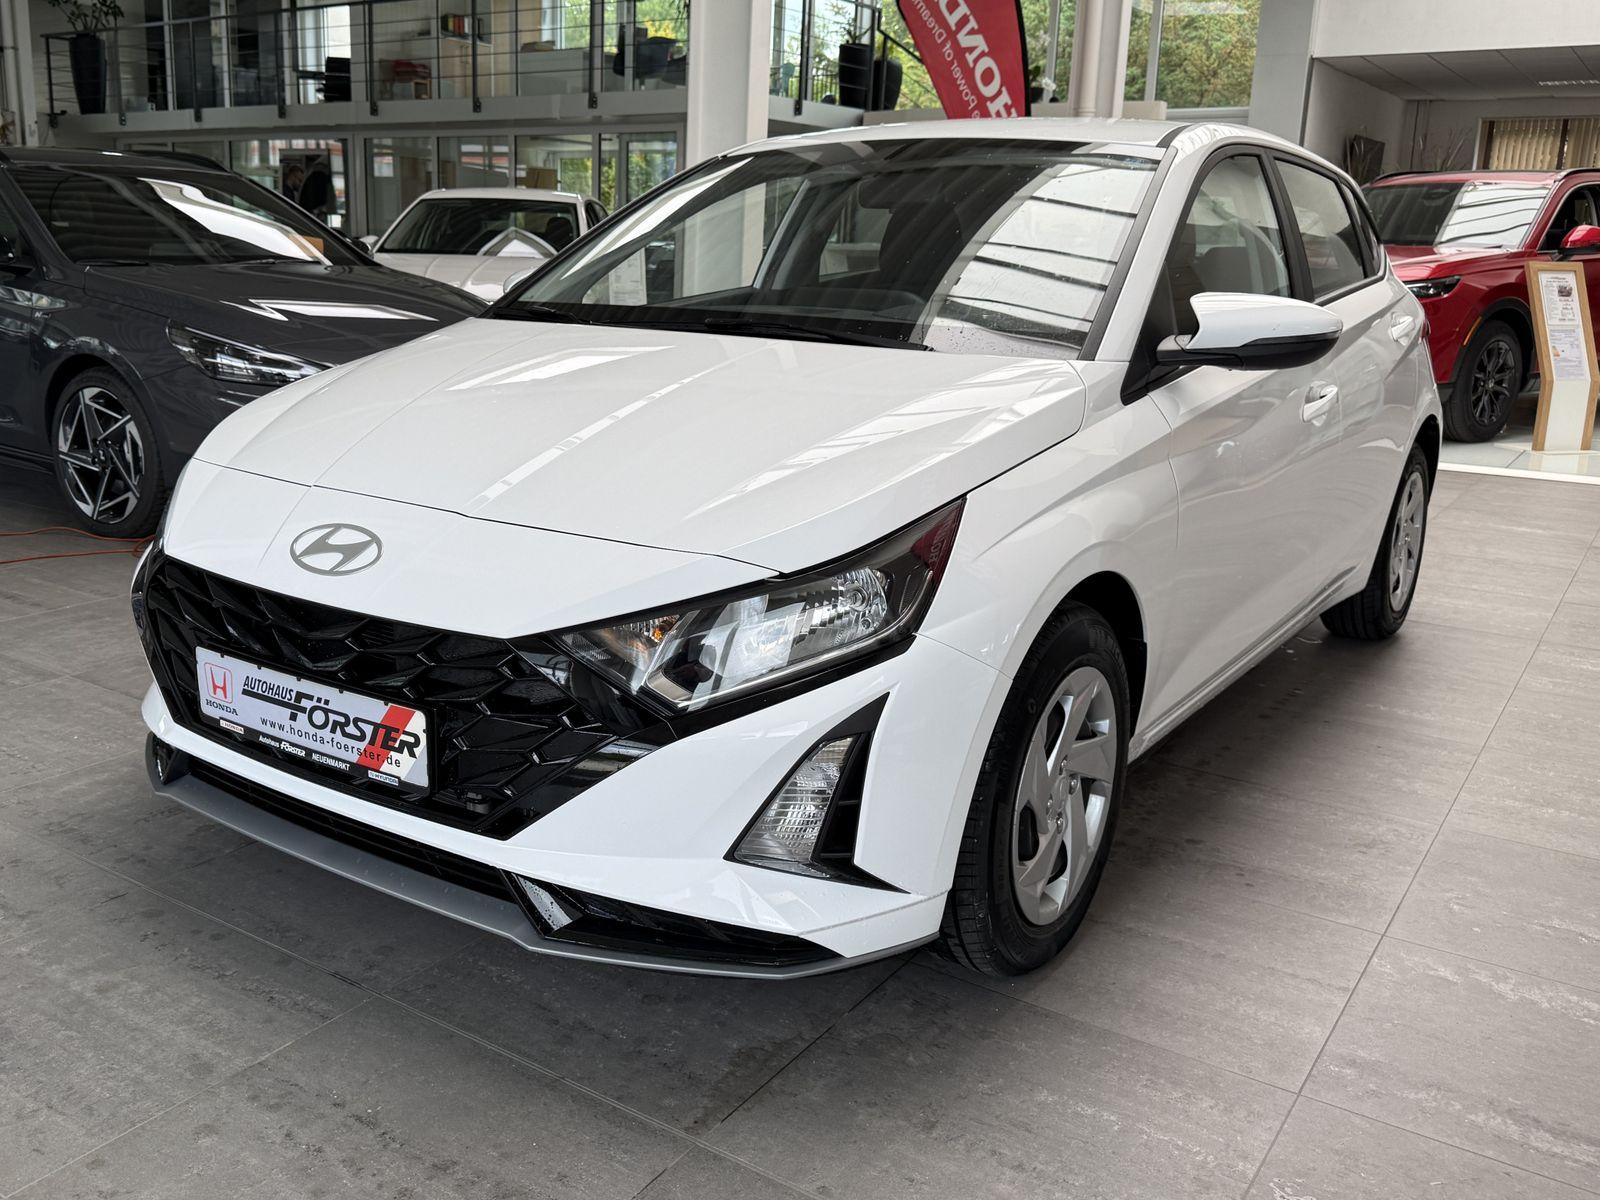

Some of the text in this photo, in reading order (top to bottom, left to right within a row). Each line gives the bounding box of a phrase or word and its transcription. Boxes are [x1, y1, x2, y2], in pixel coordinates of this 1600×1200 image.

[205, 698, 239, 716] HONDA
[243, 675, 294, 702] AUTOHAUS
[260, 716, 401, 768] www.honda-foerster.de
[286, 690, 421, 759] FÖRSTER
[259, 734, 280, 748] Autohaus
[312, 752, 351, 771] NEUENMARKT
